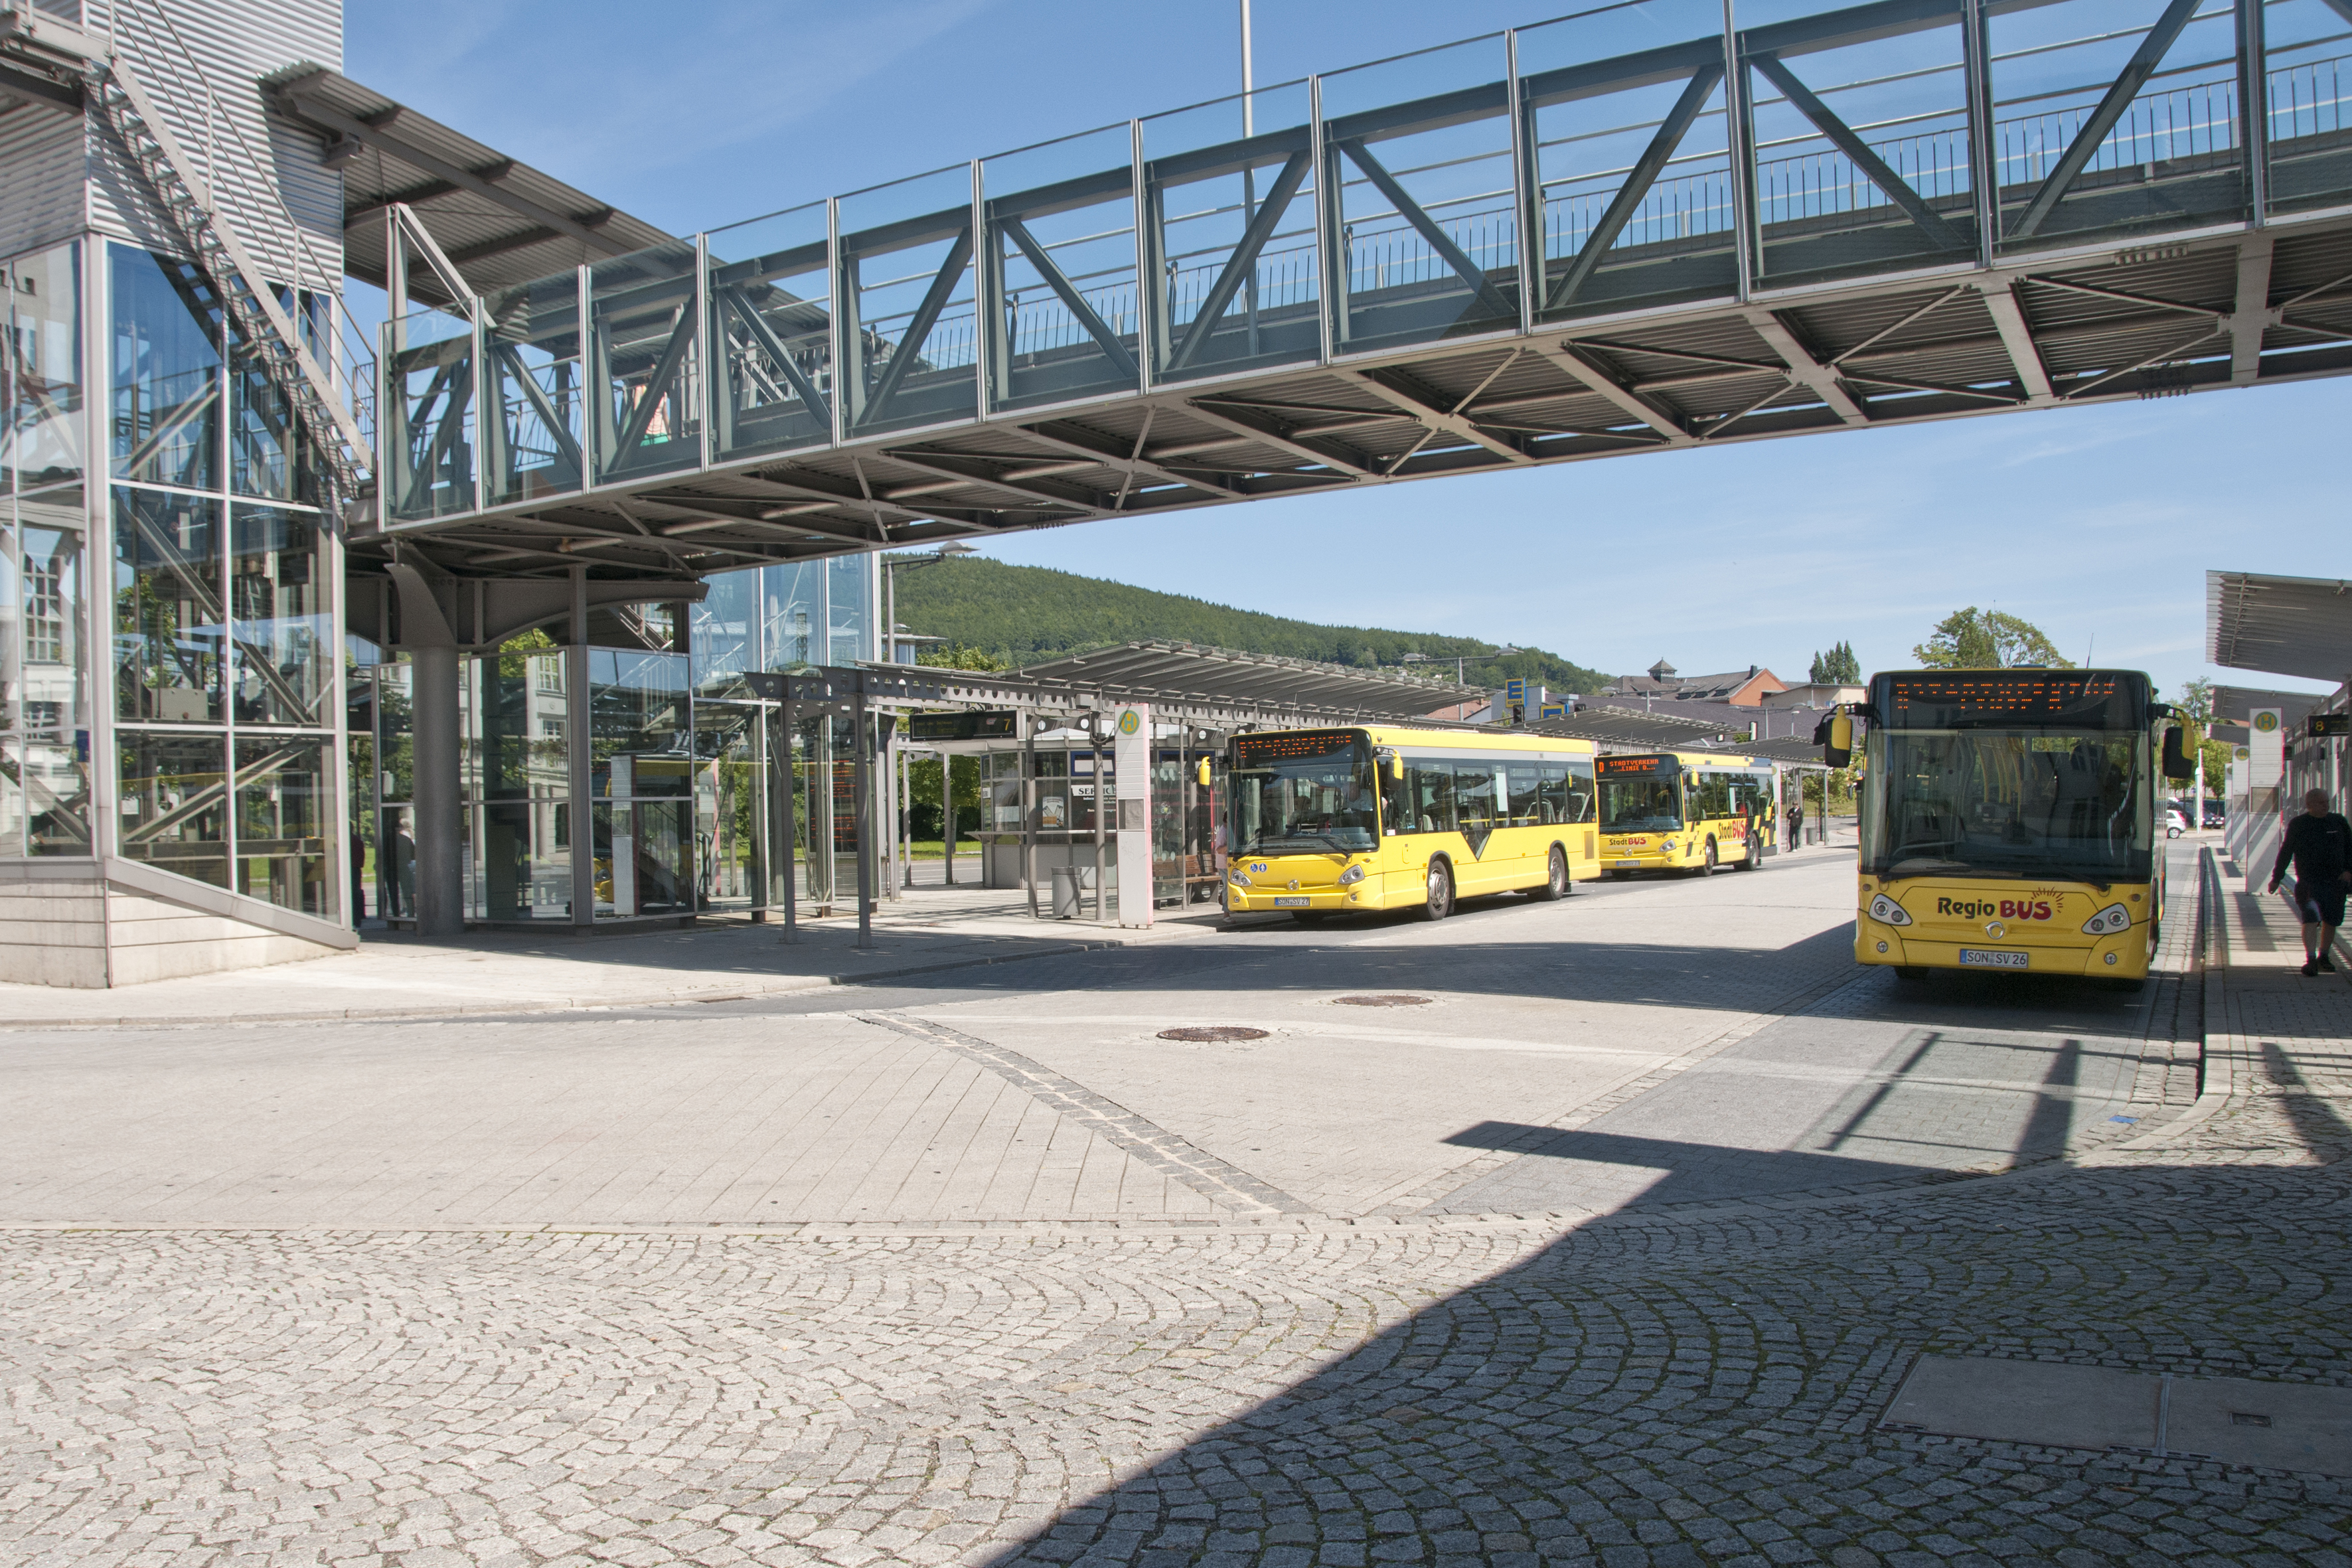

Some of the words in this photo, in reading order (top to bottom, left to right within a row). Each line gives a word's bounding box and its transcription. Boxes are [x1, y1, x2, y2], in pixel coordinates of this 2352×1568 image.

[1004, 718, 1011, 731] 7
[1124, 716, 1134, 729] H
[2260, 716, 2272, 728] H
[2315, 721, 2324, 732] 8
[1938, 898, 1996, 919] Regio
[1999, 900, 2053, 921] BUS
[1967, 952, 1989, 963] SON
[1996, 953, 2010, 964] SV
[2013, 955, 2026, 965] 26
